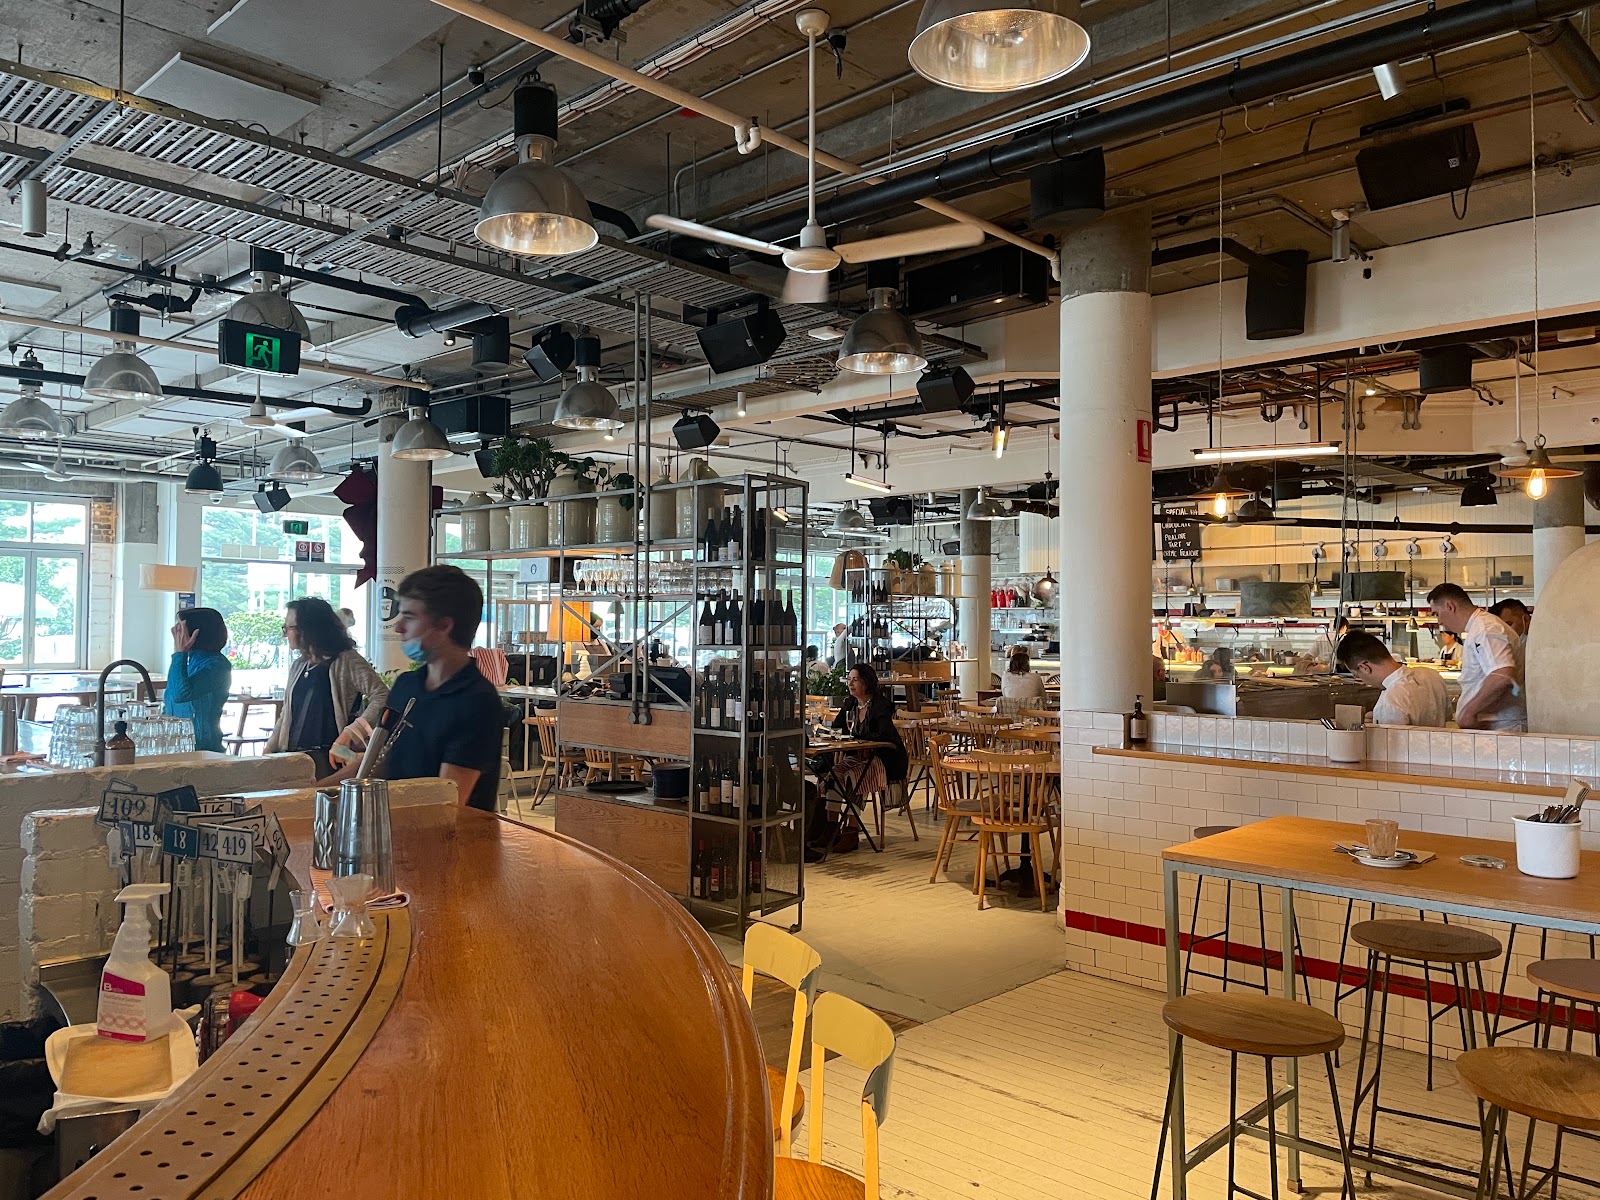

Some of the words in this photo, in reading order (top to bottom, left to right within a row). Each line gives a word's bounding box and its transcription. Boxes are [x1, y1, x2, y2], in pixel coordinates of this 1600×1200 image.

[112, 797, 147, 818] 109
[173, 829, 187, 850] 18
[222, 835, 247, 856] 419
